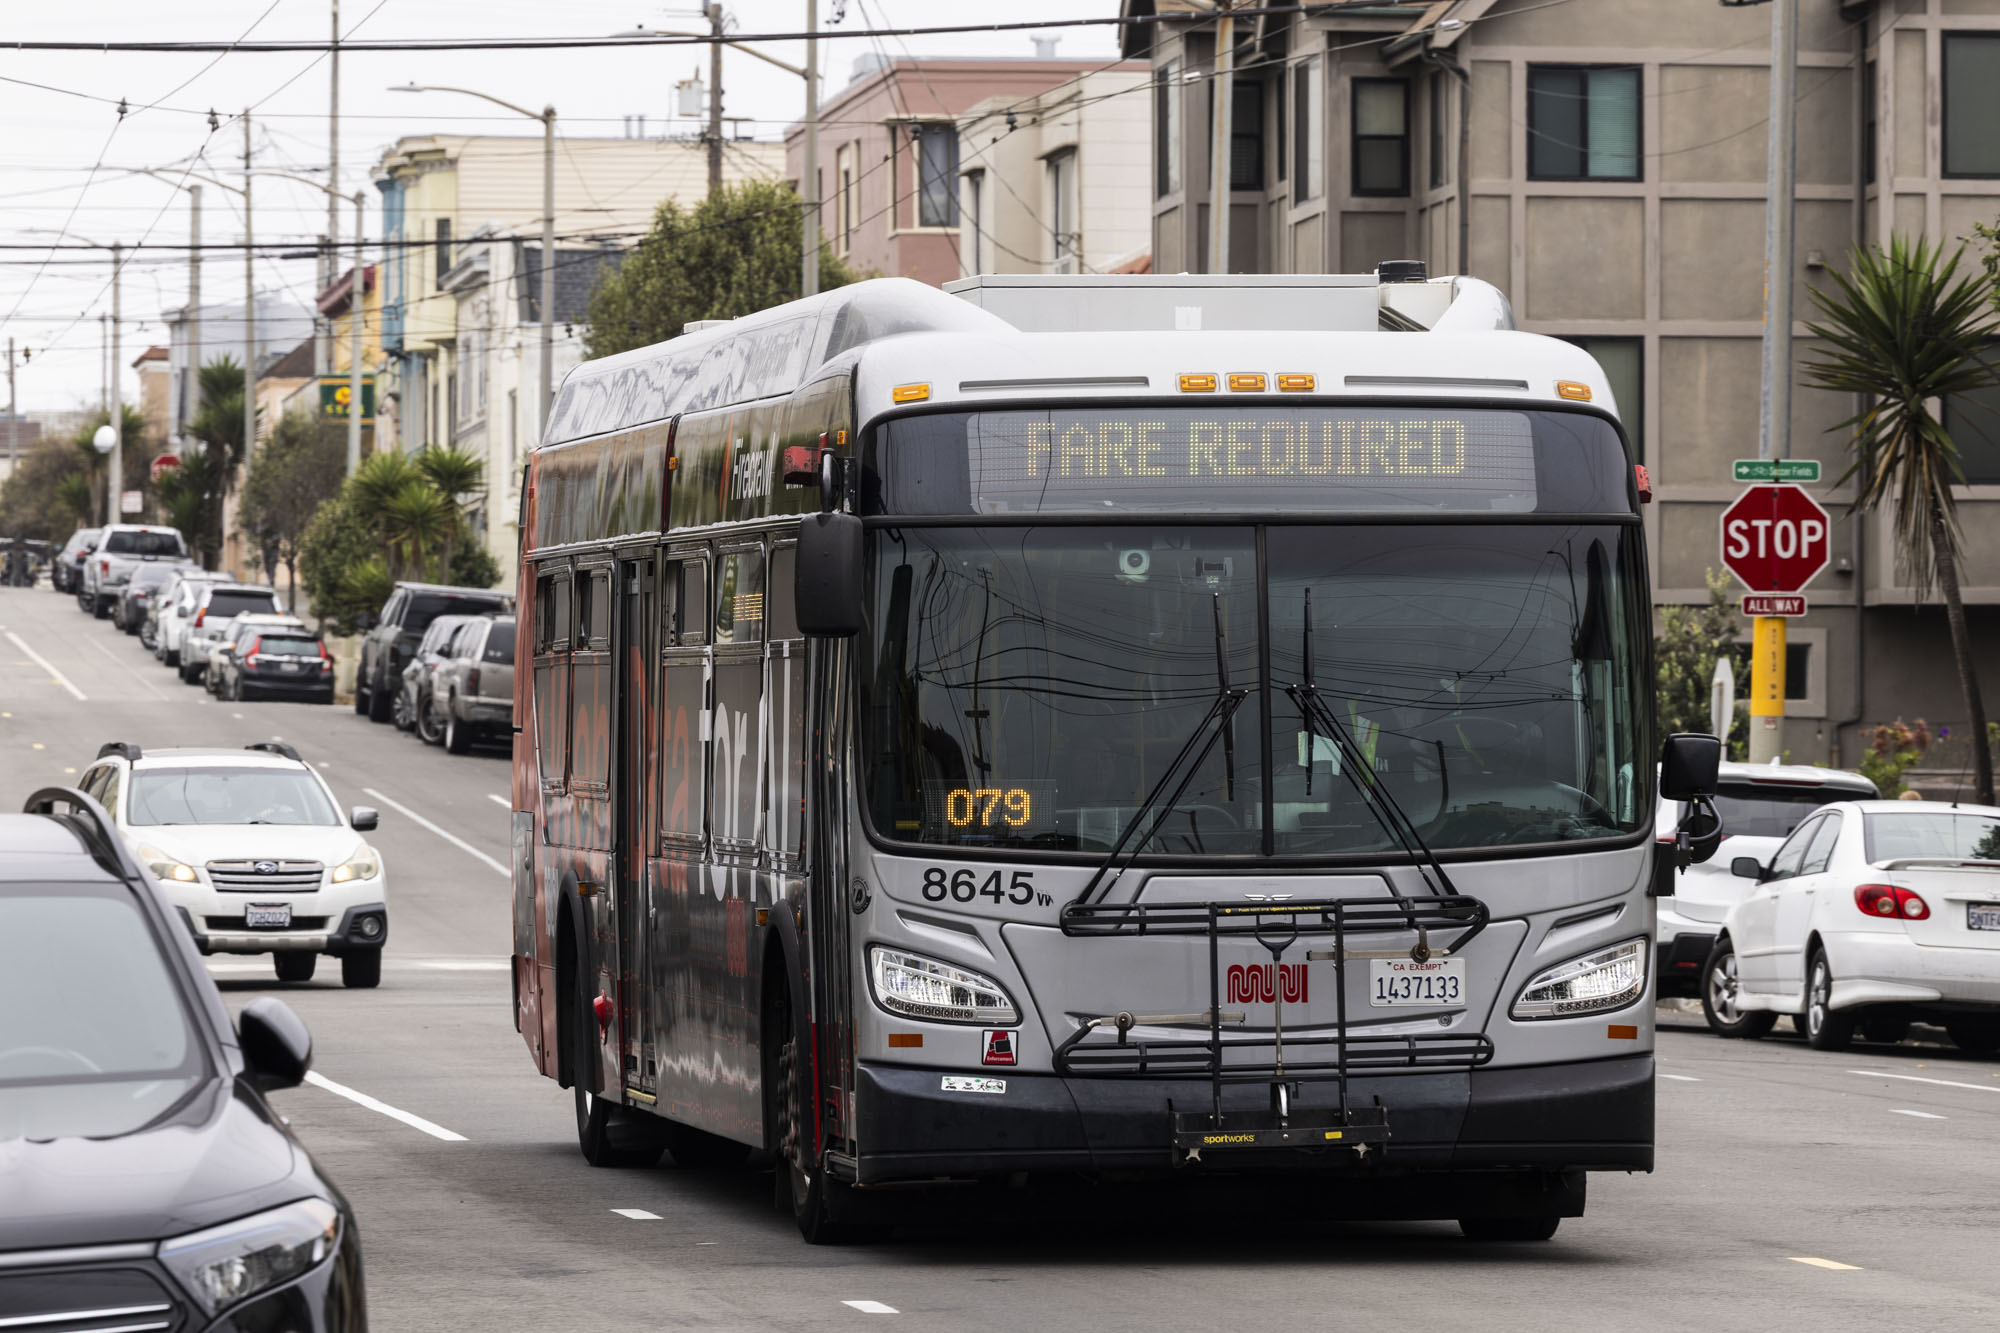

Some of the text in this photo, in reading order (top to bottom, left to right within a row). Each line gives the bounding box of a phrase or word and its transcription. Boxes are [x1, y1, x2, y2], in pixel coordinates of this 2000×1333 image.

[731, 431, 775, 501] Firecrawl
[1027, 419, 1466, 477] FARE REQUIRED
[1727, 519, 1824, 560] STOP
[1747, 600, 1801, 612] ALL WAY
[947, 788, 1031, 826] 079
[921, 867, 1034, 906] 8645
[1393, 963, 1442, 971] CA EXEMPT
[1376, 975, 1459, 1000] 1437133
[1203, 1133, 1255, 1145] sportworks
